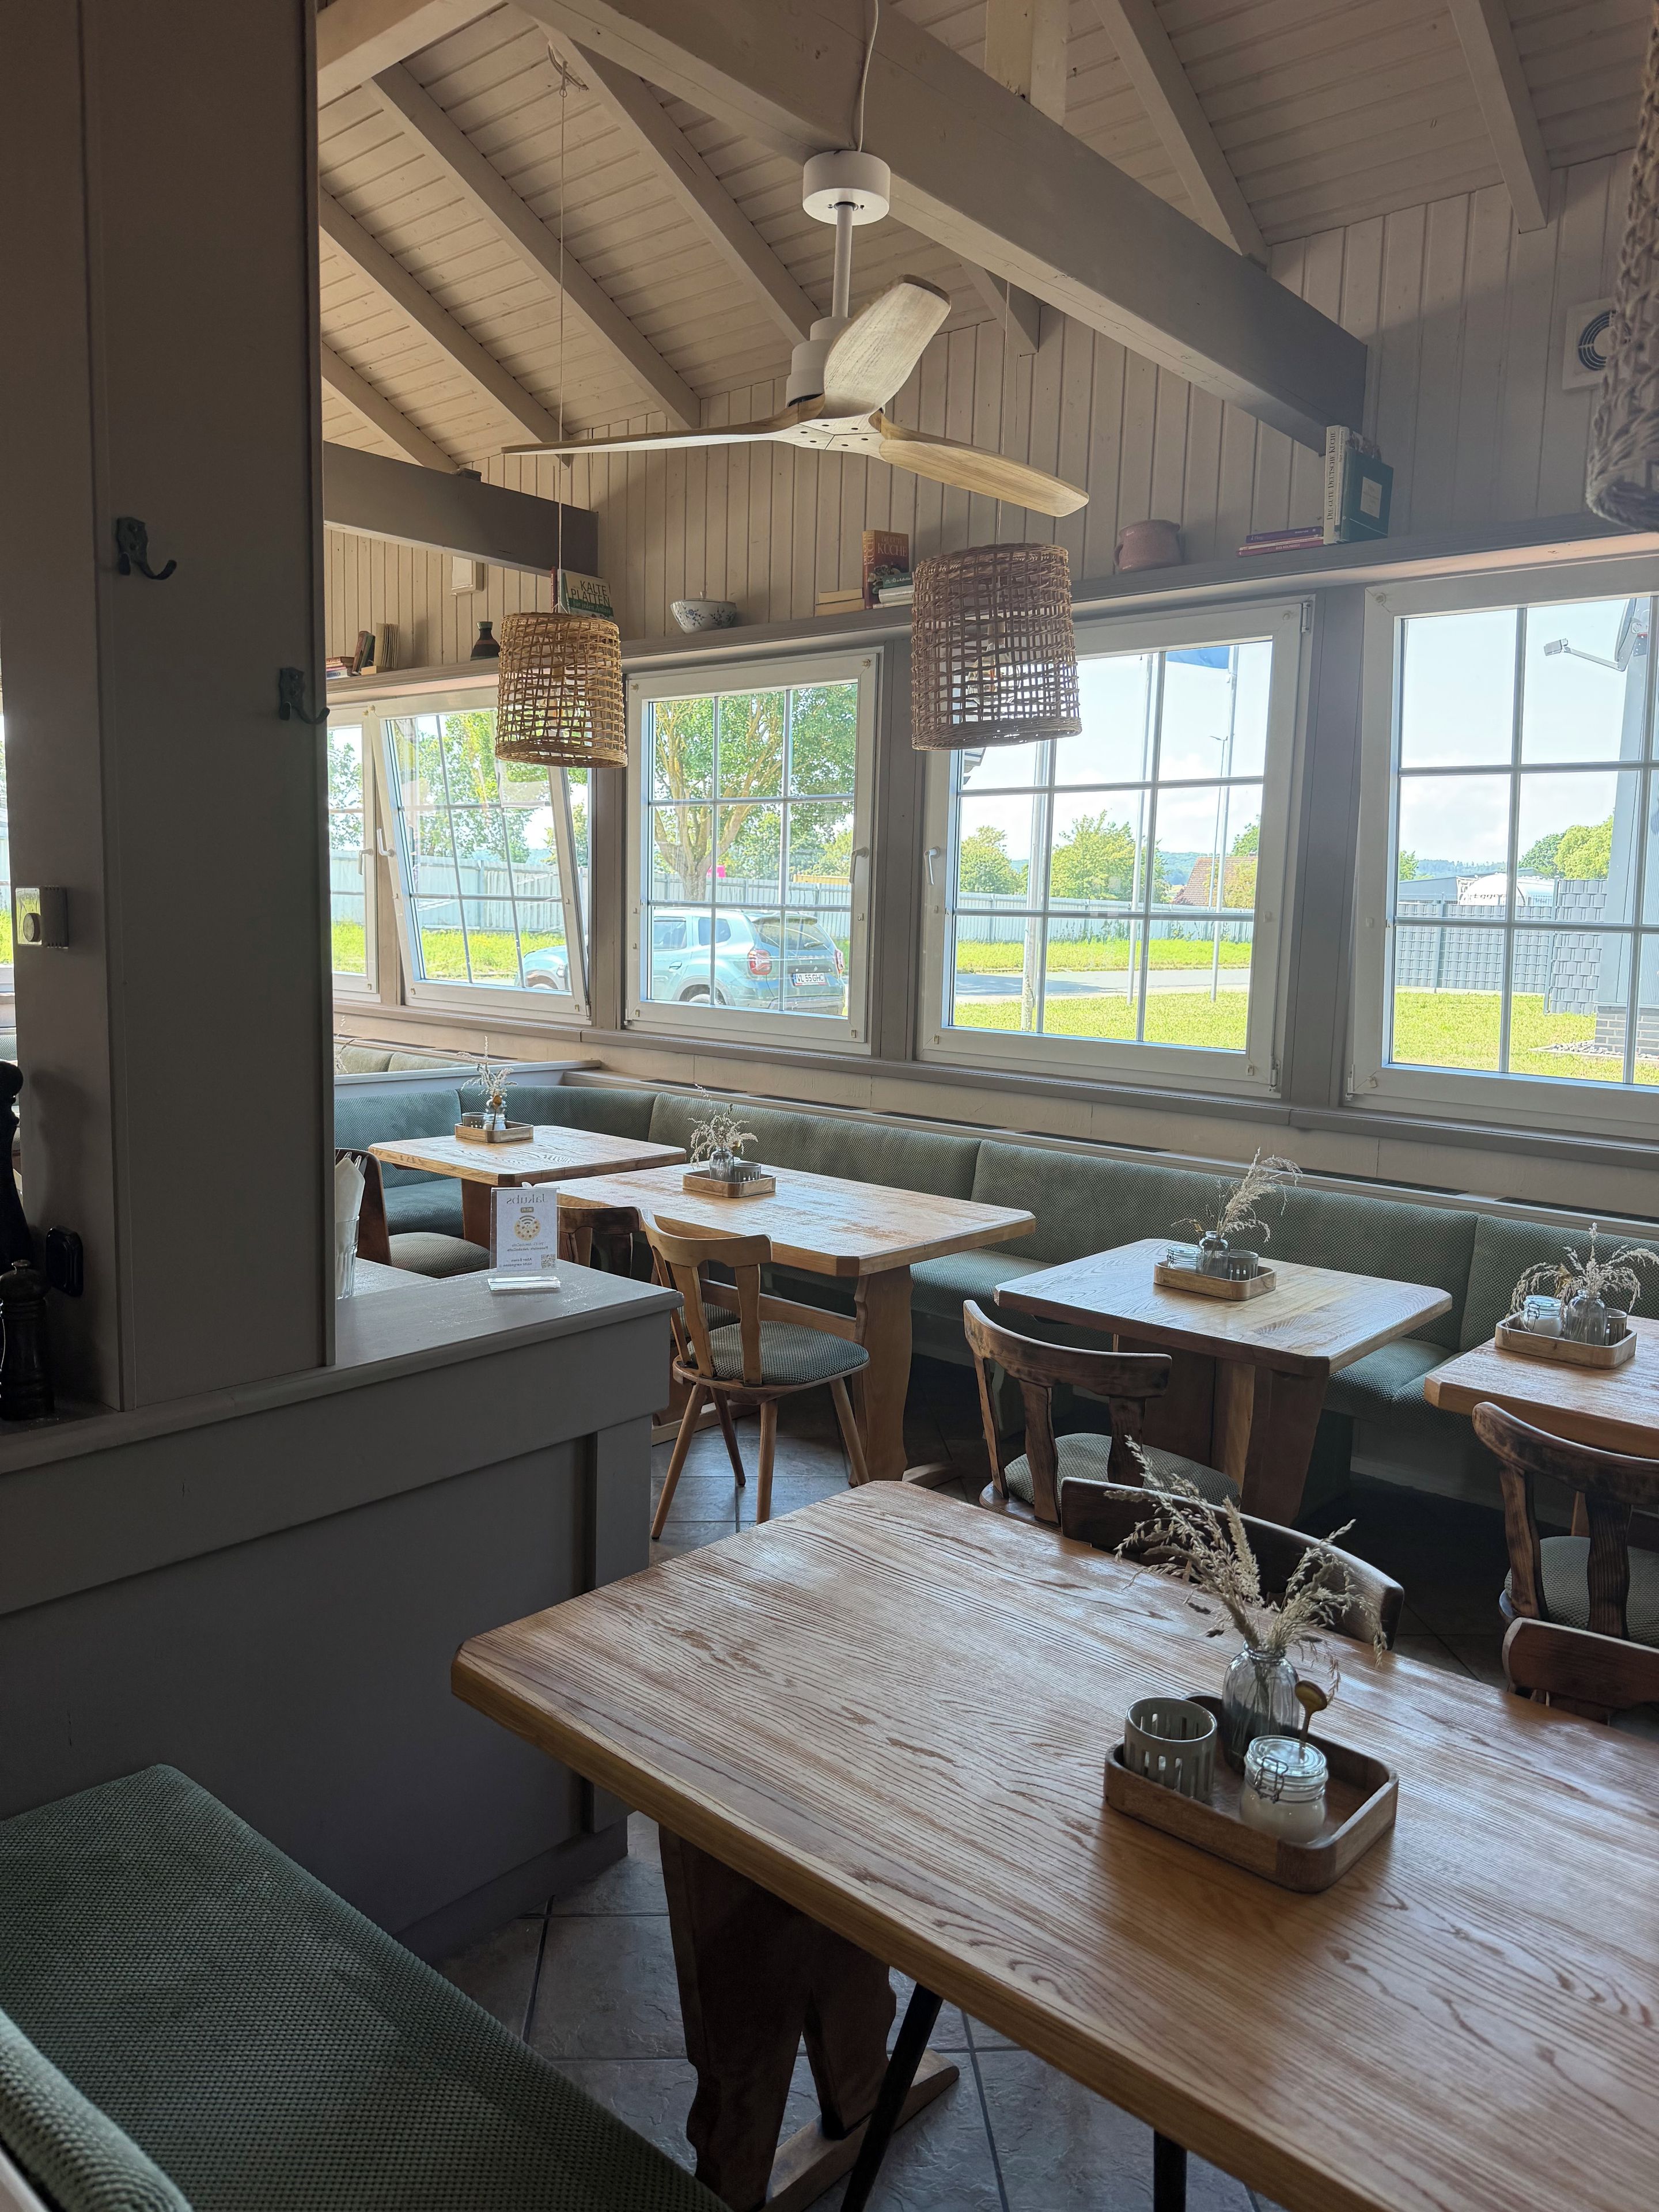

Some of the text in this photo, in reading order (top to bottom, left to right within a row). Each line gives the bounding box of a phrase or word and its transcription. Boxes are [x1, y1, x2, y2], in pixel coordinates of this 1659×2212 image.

[580, 580, 608, 597] KALTE
[571, 588, 611, 608] PLATTEN
[805, 974, 812, 982] 55
